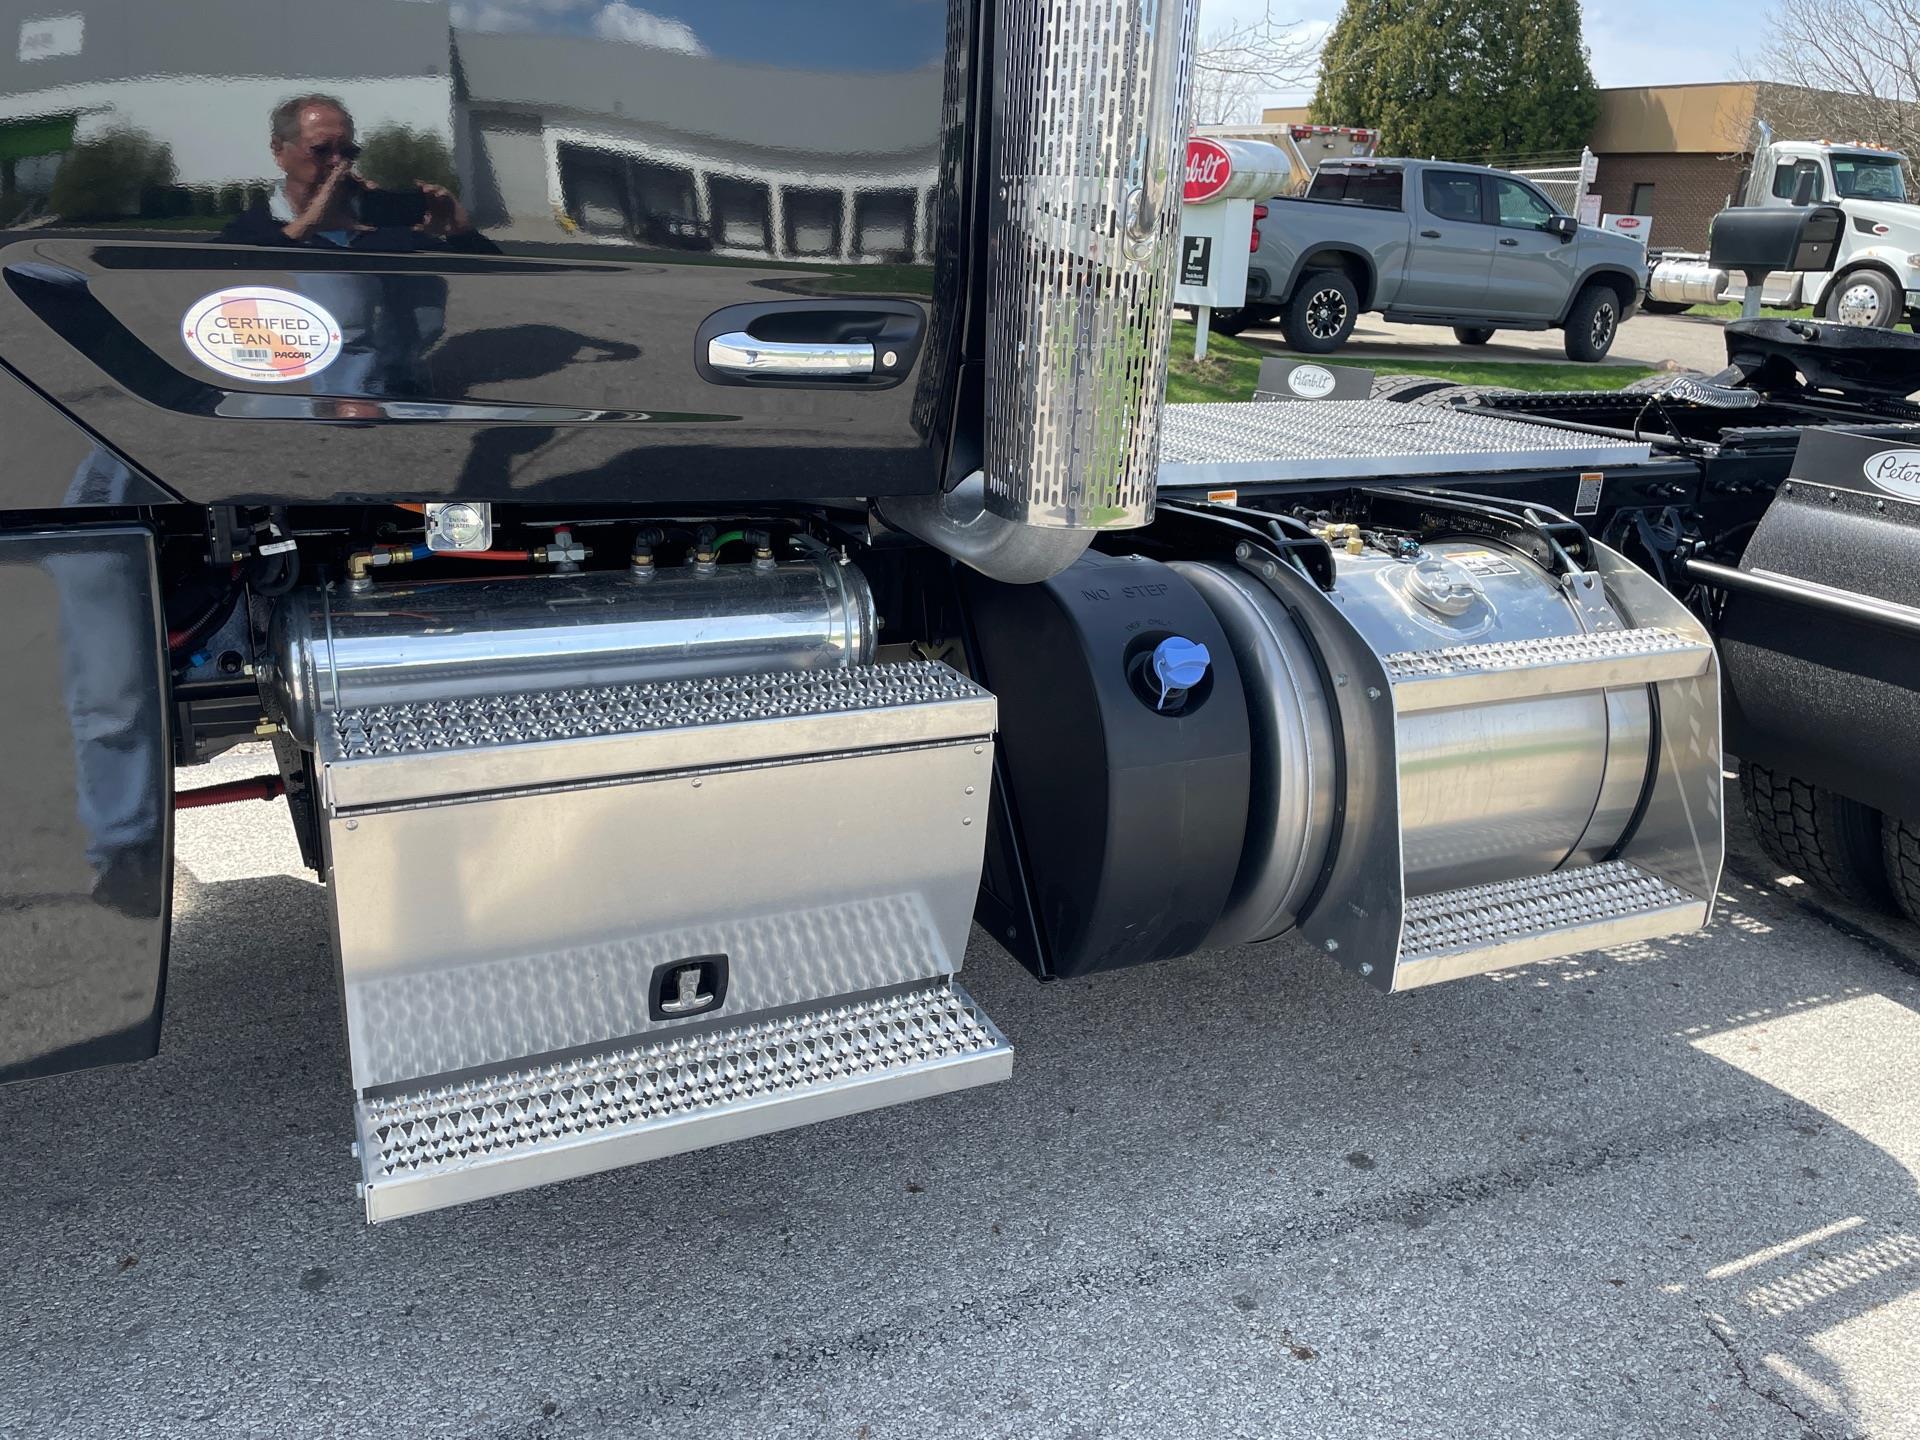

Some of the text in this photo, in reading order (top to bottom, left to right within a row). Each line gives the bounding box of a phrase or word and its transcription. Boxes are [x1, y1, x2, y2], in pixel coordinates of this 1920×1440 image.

[214, 317, 310, 330] CERTIFIED
[207, 333, 321, 346] CLEAN IDLE
[274, 351, 312, 359] PACCAR
[1081, 583, 1168, 600] NO STEP
